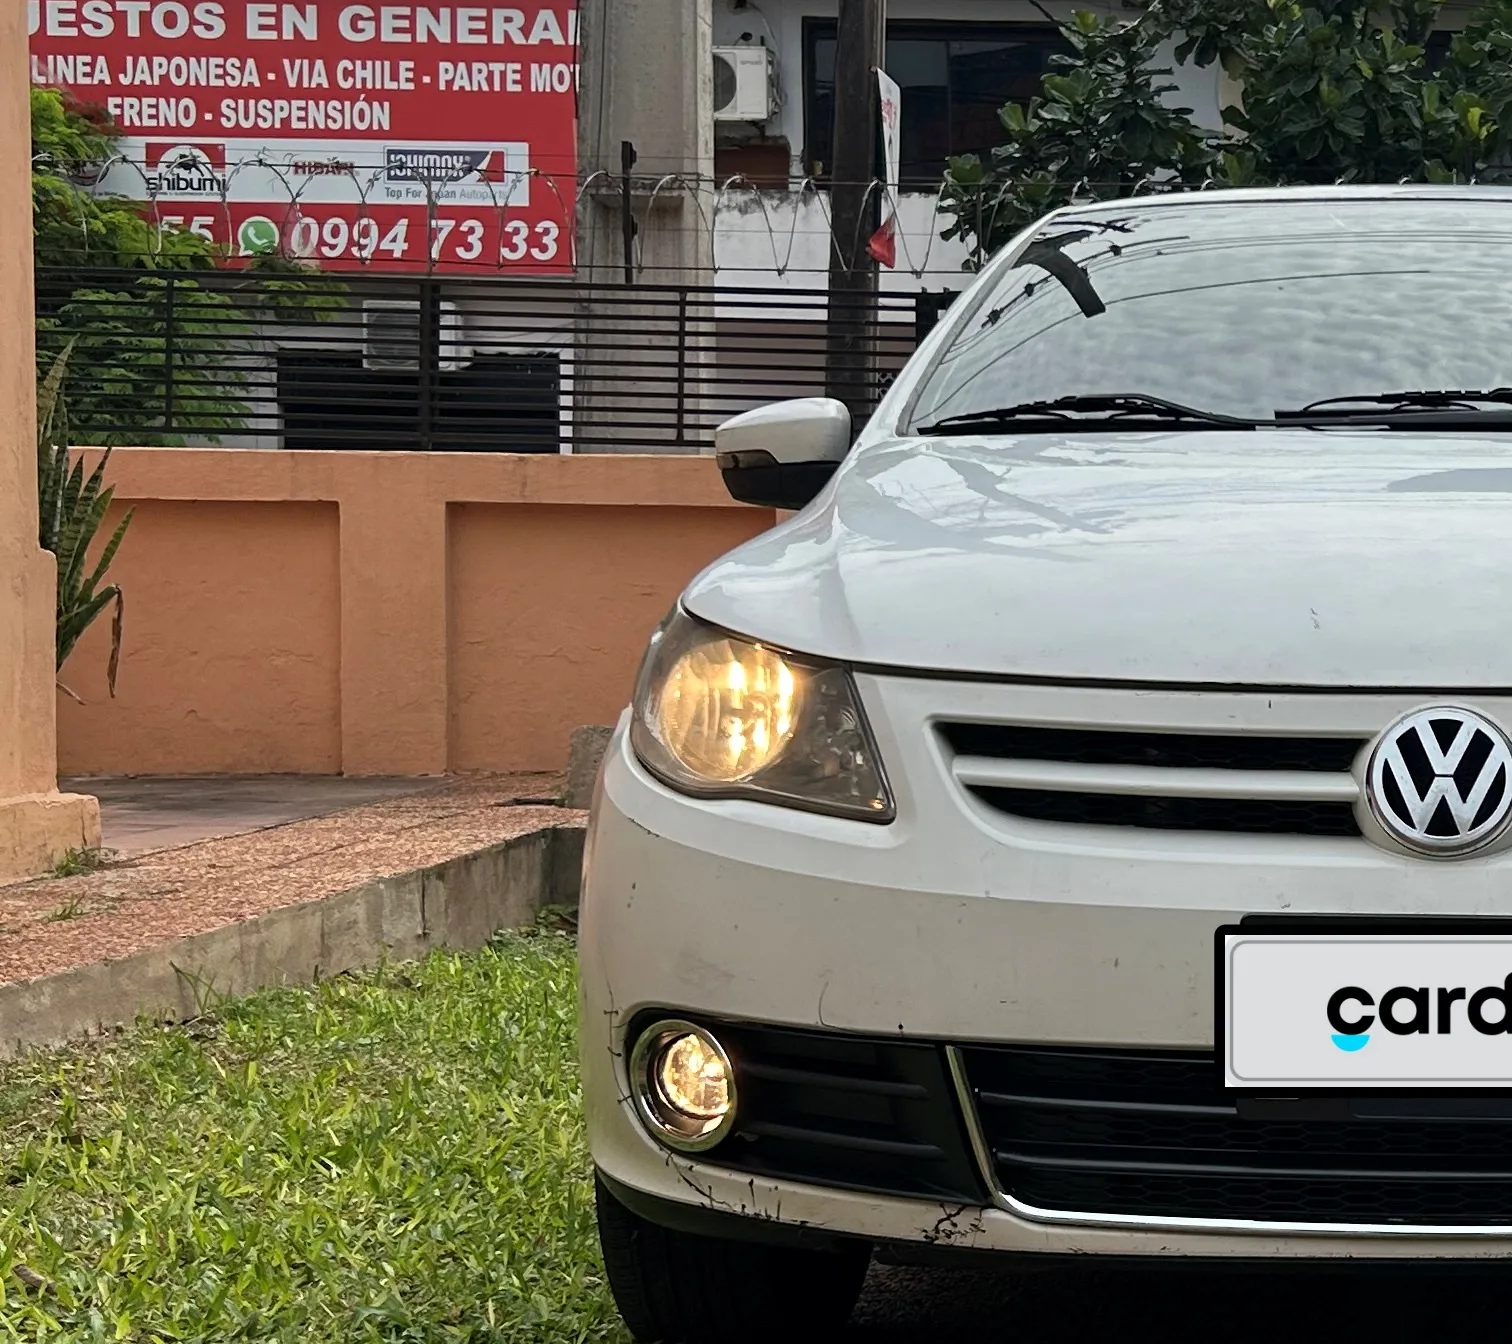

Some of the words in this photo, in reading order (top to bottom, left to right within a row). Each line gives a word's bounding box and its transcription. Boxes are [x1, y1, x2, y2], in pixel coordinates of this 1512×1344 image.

[246, 3, 318, 41] EN
[31, 55, 112, 85] LINEA
[118, 56, 261, 87] JAPONESA
[283, 58, 329, 88] VIA
[336, 60, 415, 90] CHILE
[438, 61, 523, 92] PARTE
[107, 97, 197, 128] FRENO
[220, 94, 391, 131] SUSPENSIÓN
[291, 216, 408, 261] 0994
[431, 218, 485, 261] 73
[500, 219, 560, 261] 33
